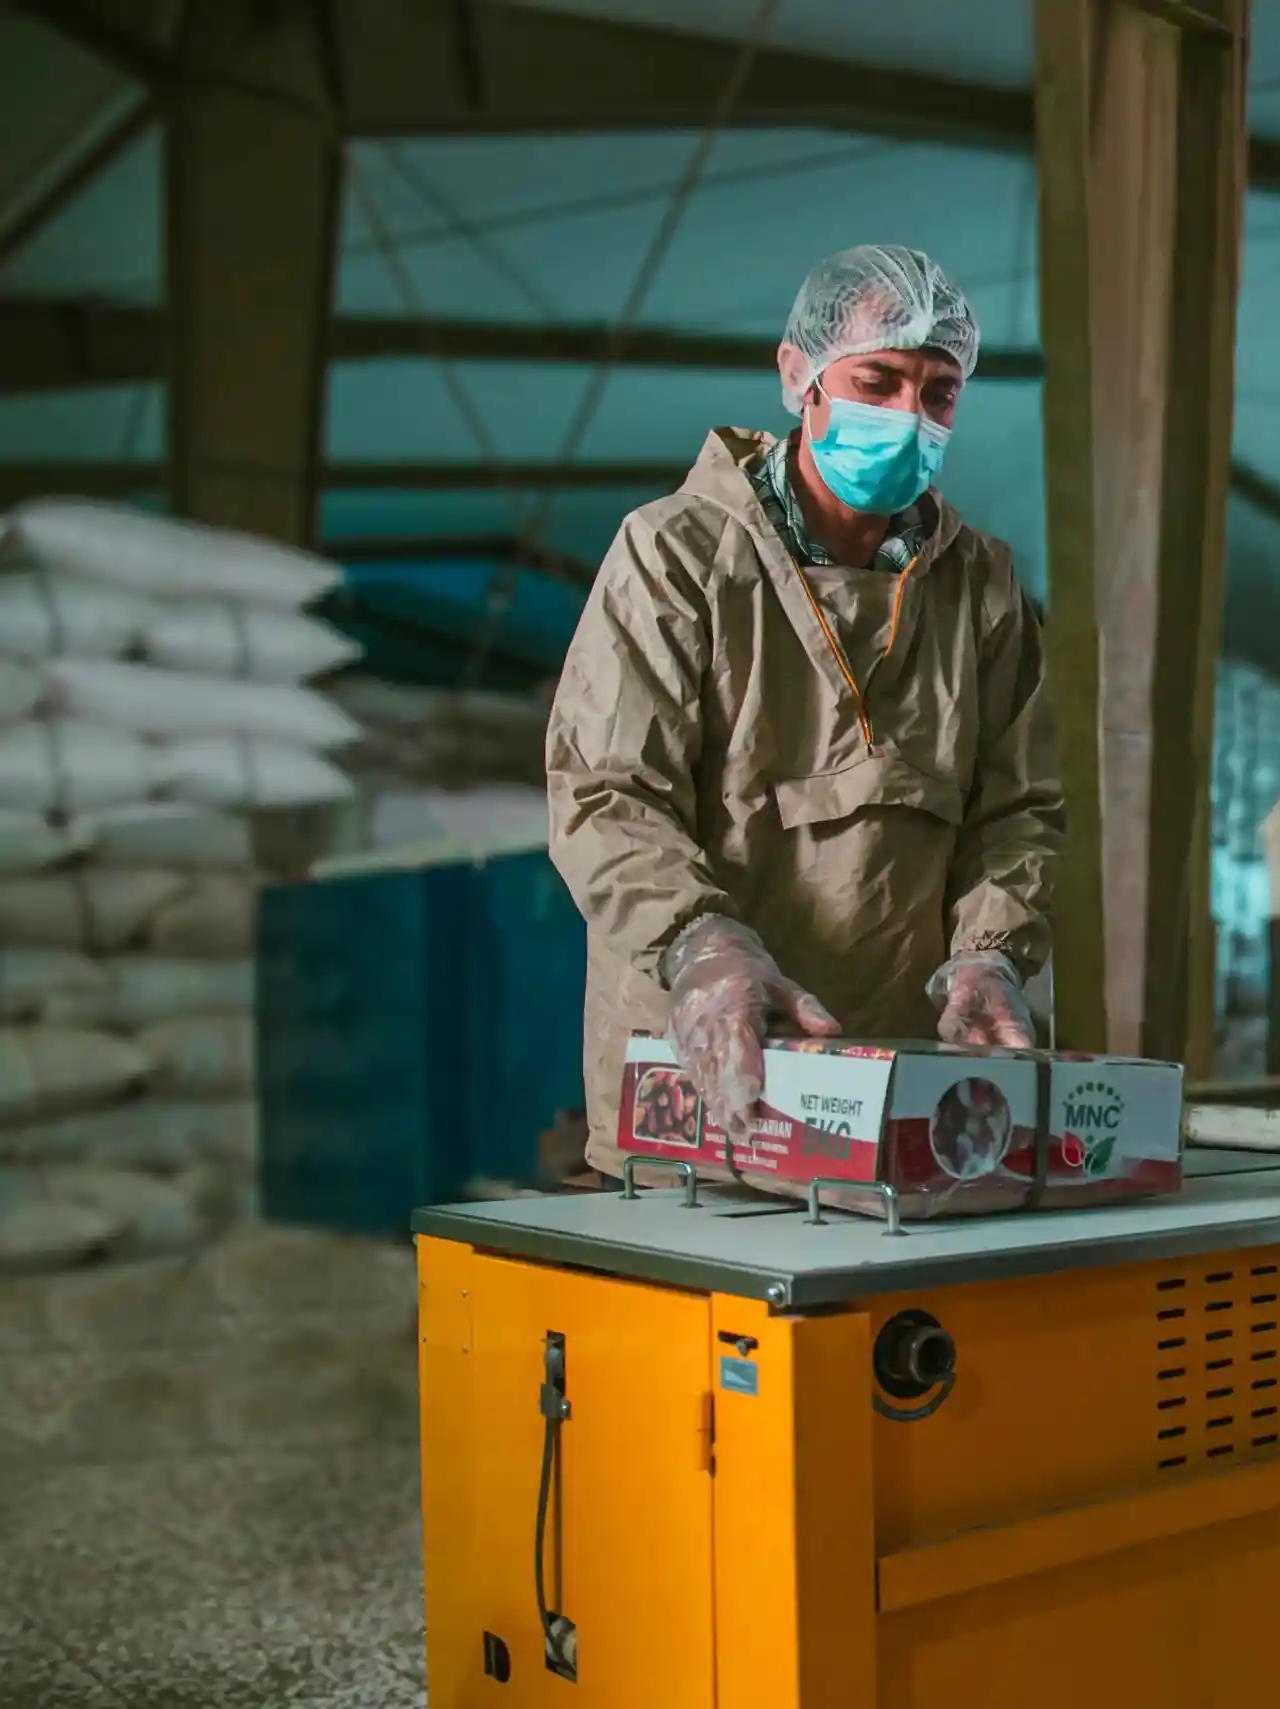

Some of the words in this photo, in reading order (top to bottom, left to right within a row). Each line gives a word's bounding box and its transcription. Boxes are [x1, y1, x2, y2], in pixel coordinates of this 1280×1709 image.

[800, 1093, 819, 1112] NET
[821, 1096, 863, 1117] WEIGHT
[1065, 1104, 1121, 1129] MNC
[801, 1117, 851, 1160] 5KG
